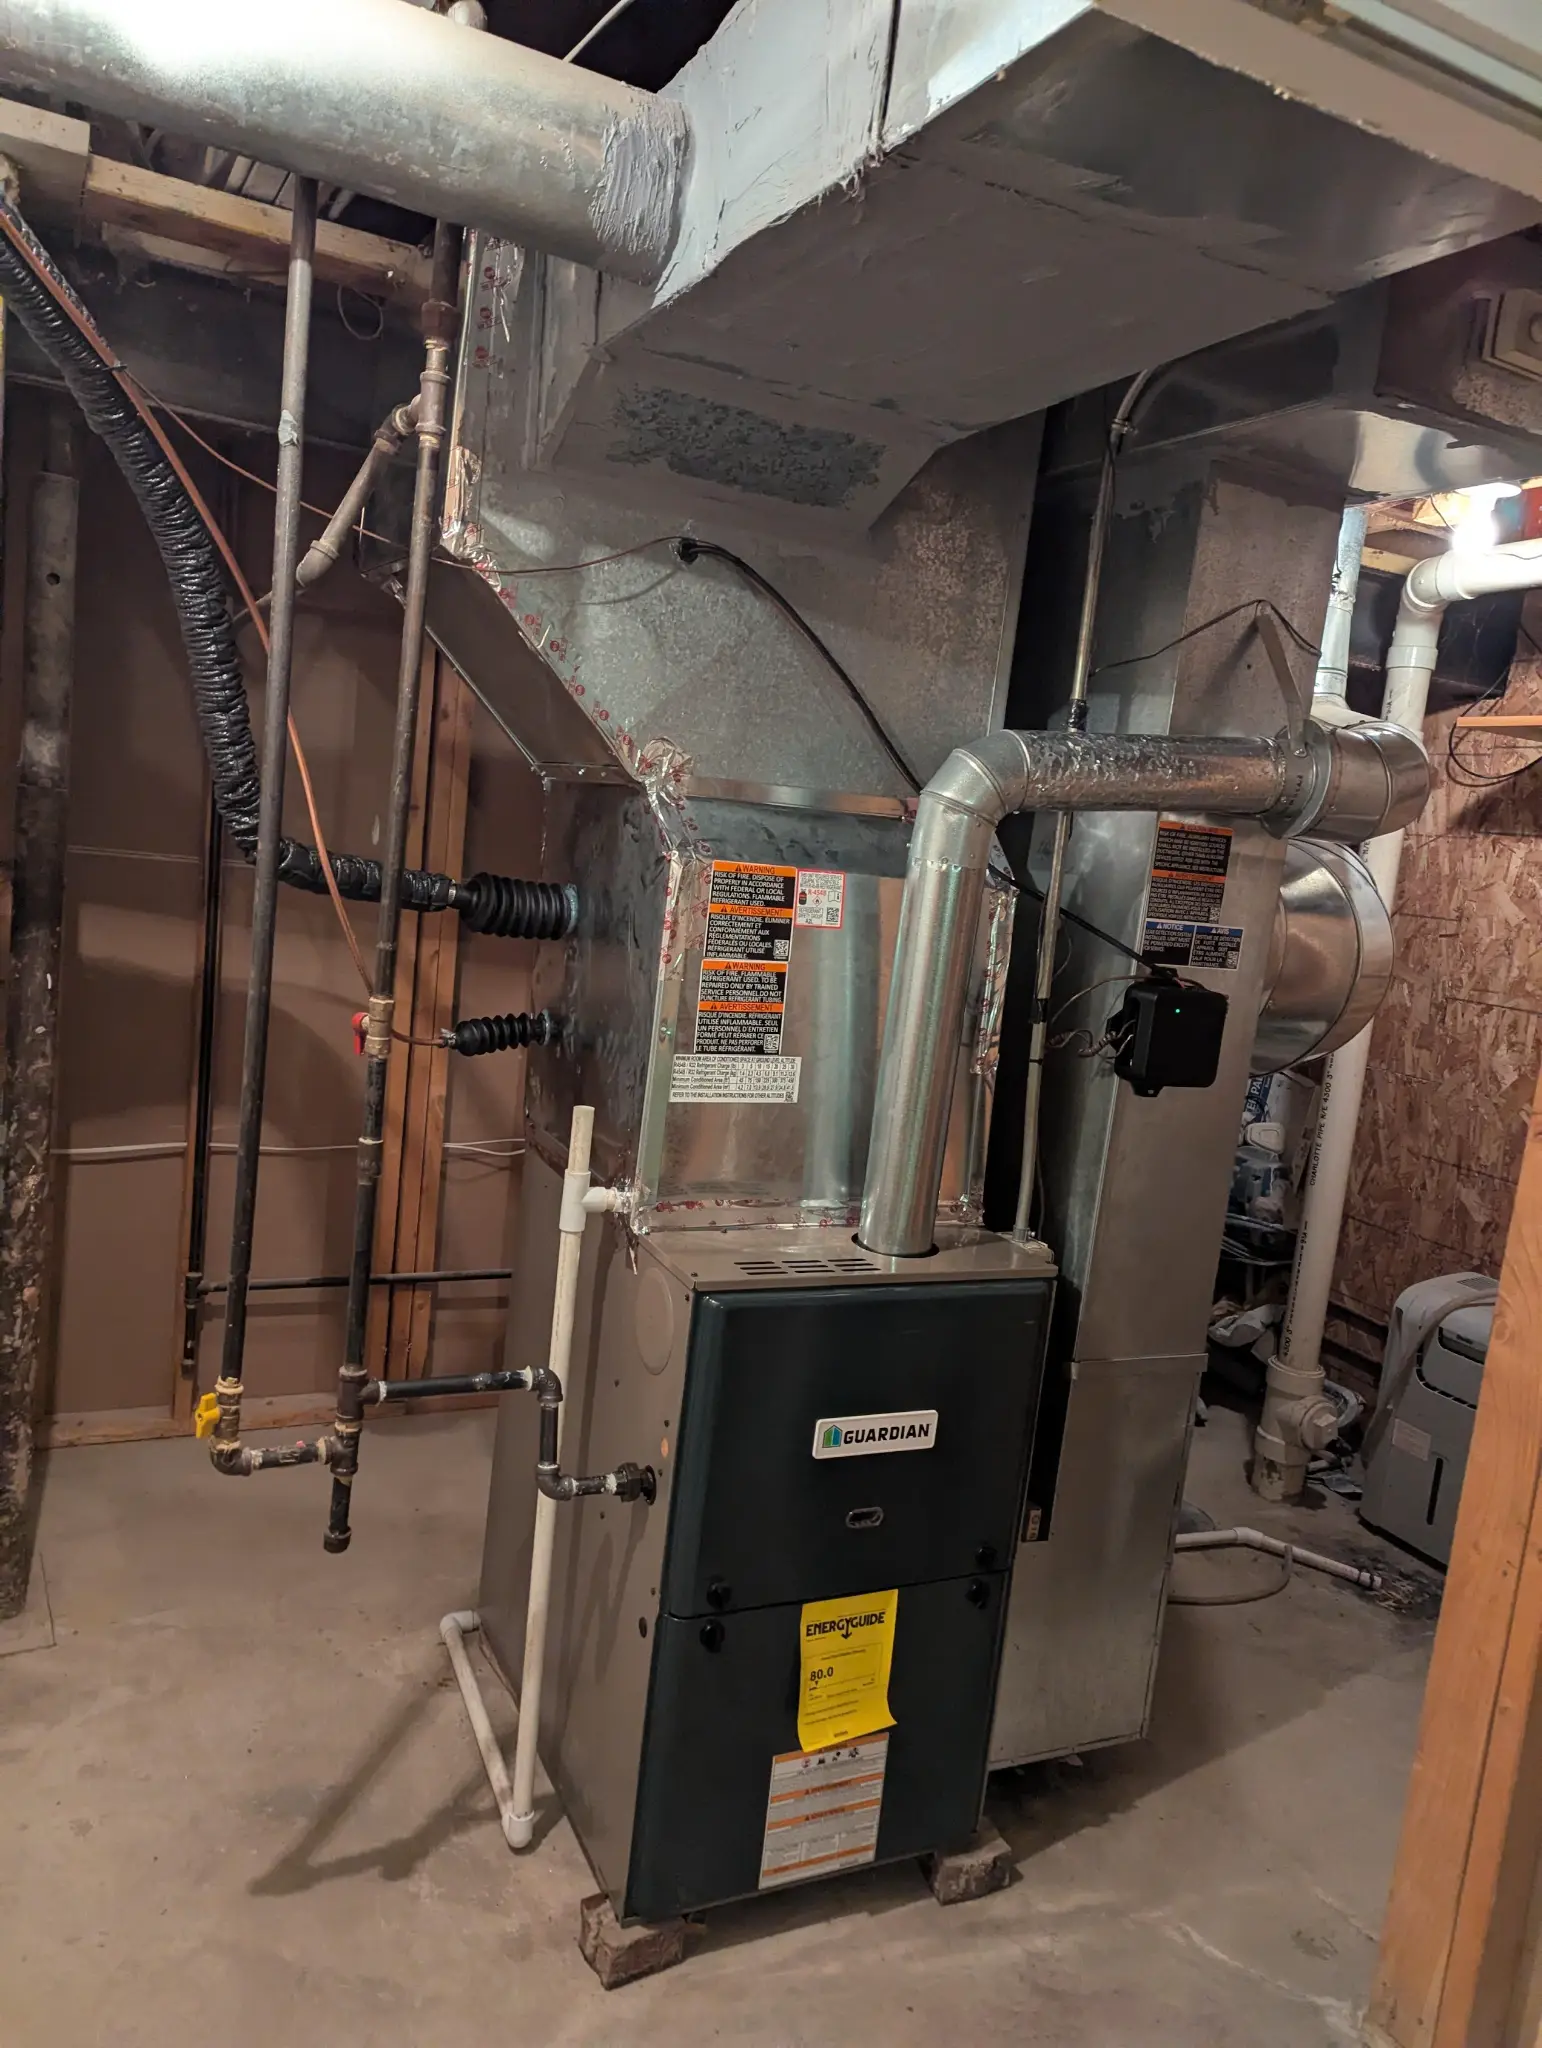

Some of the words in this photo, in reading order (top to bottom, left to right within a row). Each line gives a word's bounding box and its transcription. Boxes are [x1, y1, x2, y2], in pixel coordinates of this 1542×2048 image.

[743, 864, 775, 874] WARNING
[730, 907, 782, 915] AVERTISSEMENT
[1310, 1143, 1322, 1186] CHARLOTTE
[1317, 1122, 1325, 1139] PIPE
[844, 1424, 930, 1444] GUARDIAN
[806, 1612, 886, 1637] ENERGYGUIDE
[810, 1667, 834, 1681] 80.0
